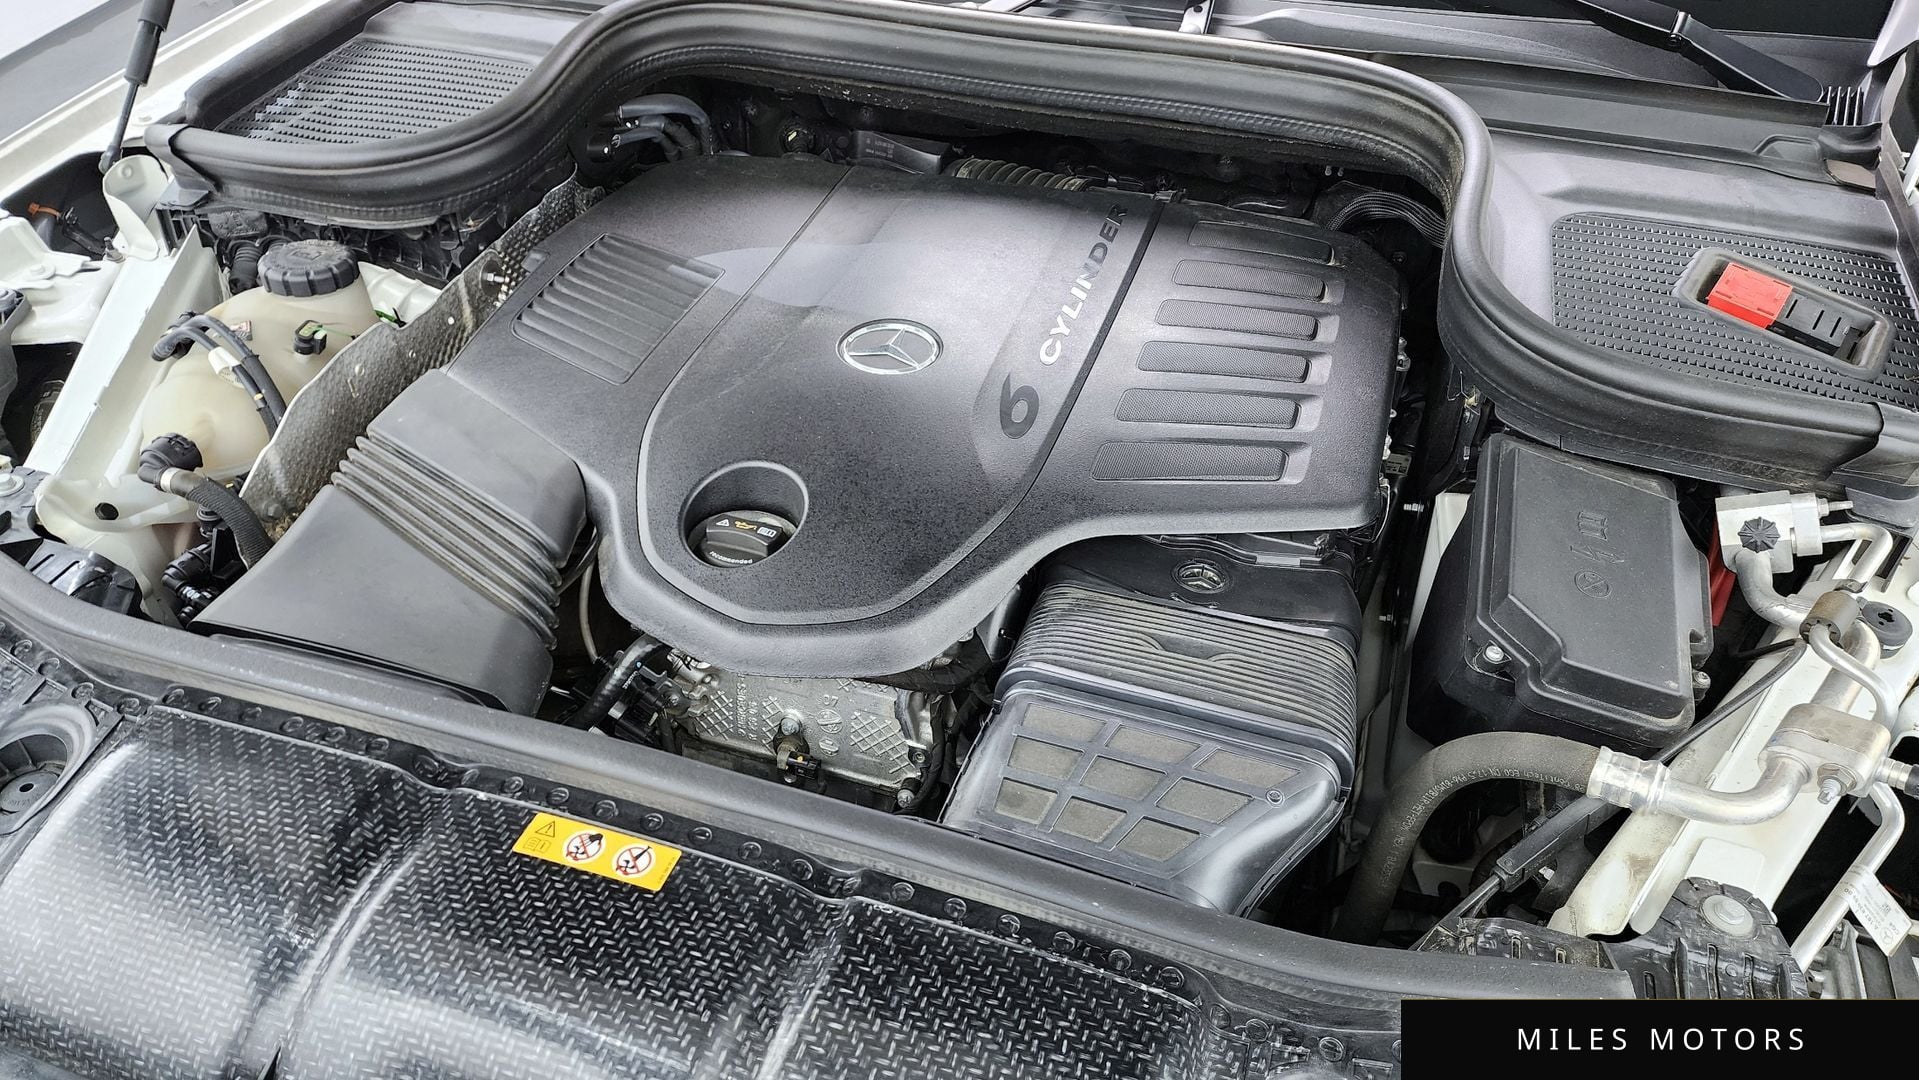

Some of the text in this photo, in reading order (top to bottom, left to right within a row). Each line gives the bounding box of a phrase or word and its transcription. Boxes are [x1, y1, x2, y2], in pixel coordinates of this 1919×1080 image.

[1000, 204, 1128, 439] 6 CYLINDER
[709, 551, 753, 564] recommended
